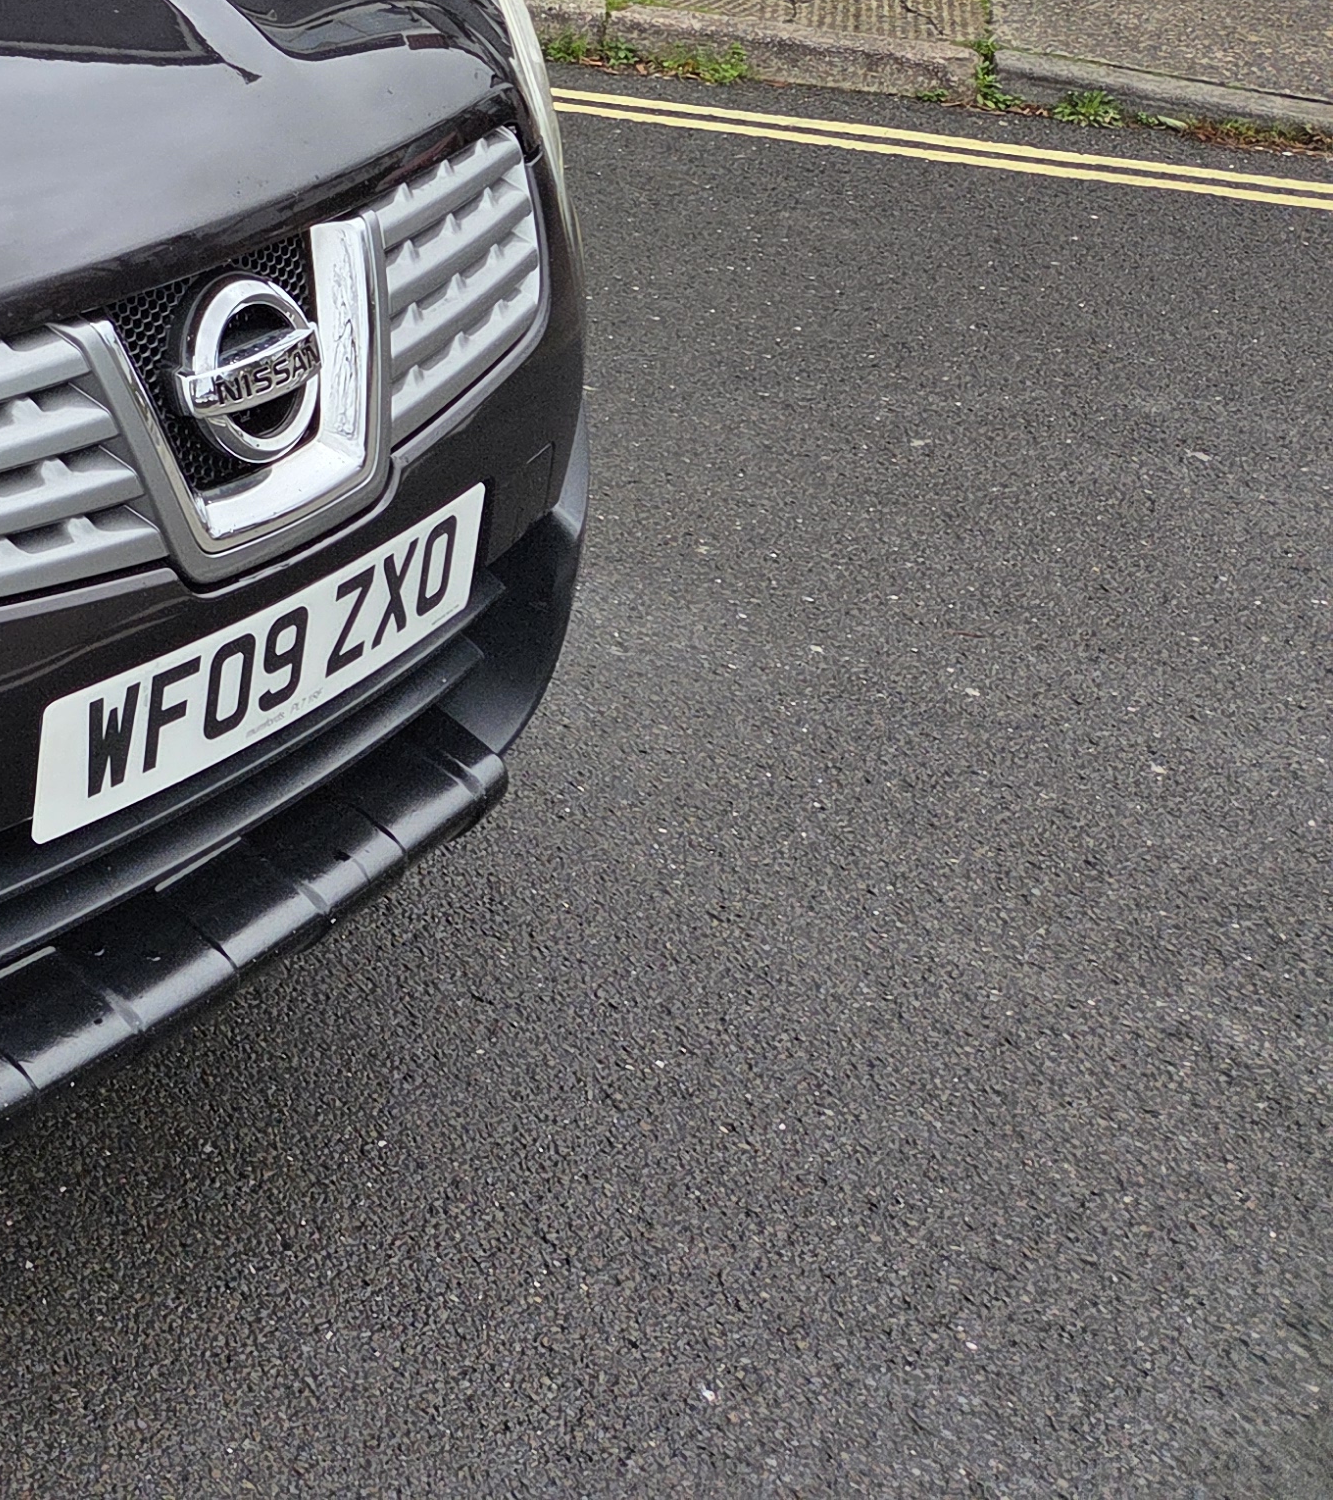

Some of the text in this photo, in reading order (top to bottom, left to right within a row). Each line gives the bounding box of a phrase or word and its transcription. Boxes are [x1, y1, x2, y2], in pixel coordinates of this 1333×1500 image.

[214, 342, 321, 406] NISSAN
[86, 513, 459, 799] WF09 ZXO
